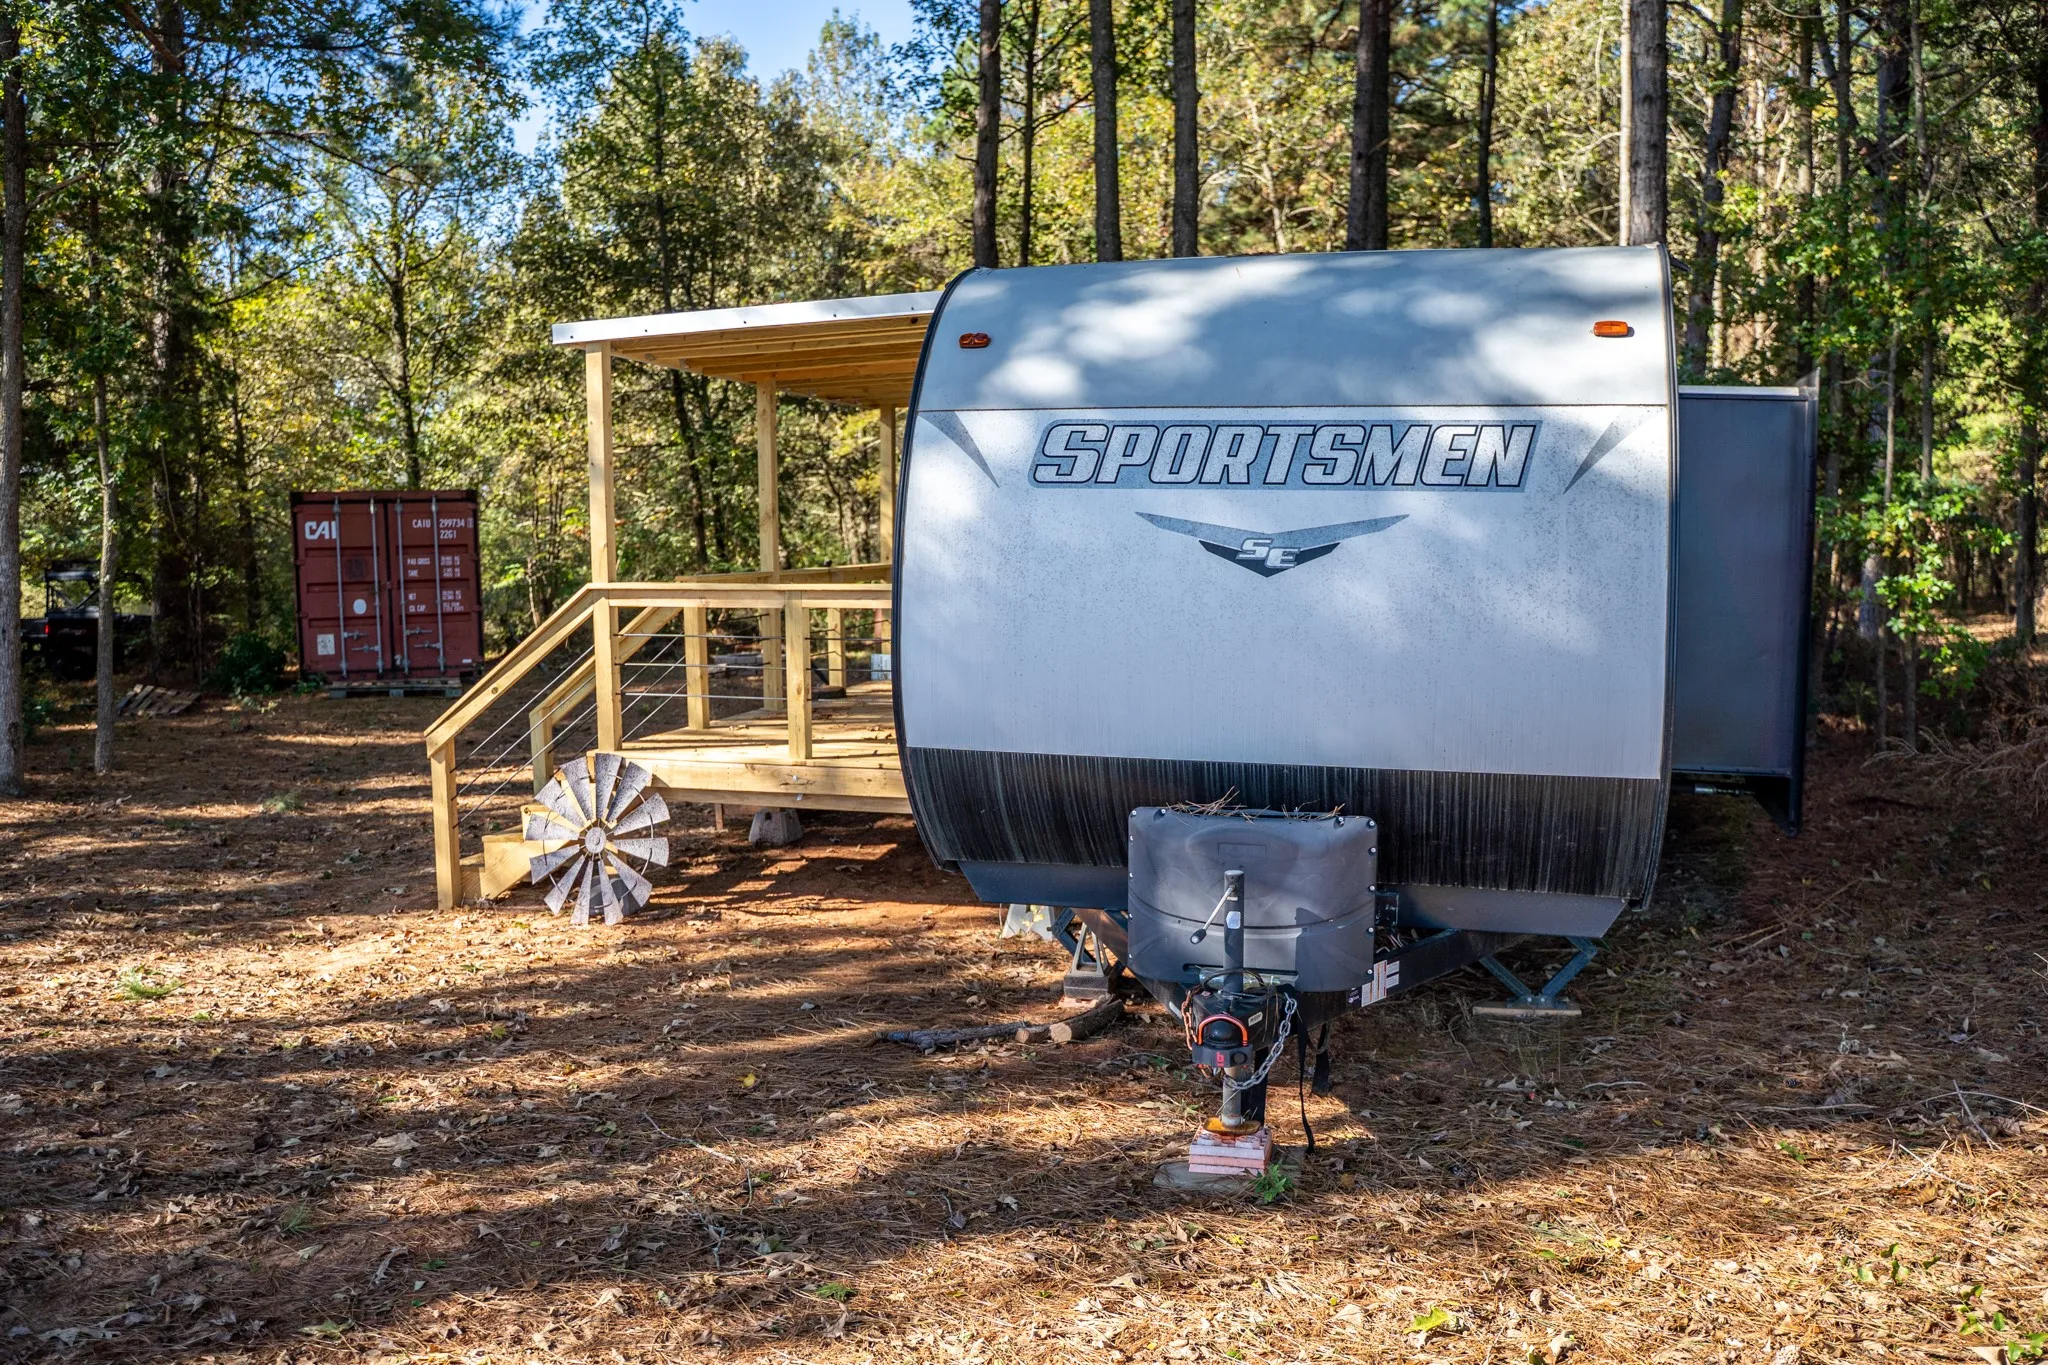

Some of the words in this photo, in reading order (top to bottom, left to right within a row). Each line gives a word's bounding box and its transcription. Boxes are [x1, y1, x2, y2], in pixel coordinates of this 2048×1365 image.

[1033, 423, 1537, 488] SPORTSMEN
[304, 520, 337, 540] CAI
[412, 518, 431, 528] CAIU
[439, 518, 465, 528] 299734
[440, 530, 457, 539] 22G1
[1235, 537, 1301, 569] SE
